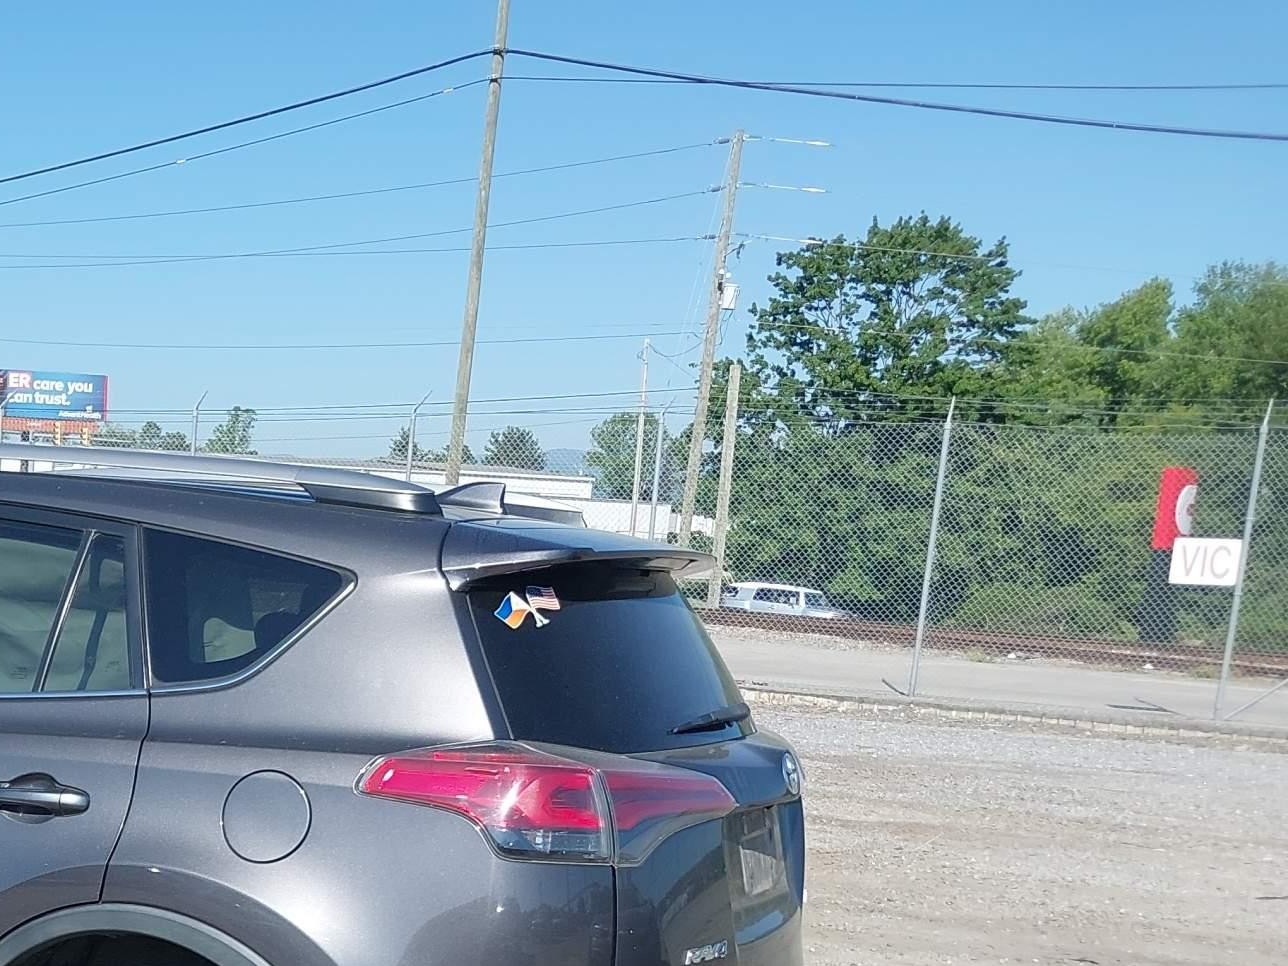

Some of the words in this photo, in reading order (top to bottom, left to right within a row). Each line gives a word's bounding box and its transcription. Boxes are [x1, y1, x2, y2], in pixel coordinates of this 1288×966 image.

[7, 373, 31, 388] ER
[33, 380, 64, 391] care
[67, 382, 94, 395] you
[7, 392, 32, 404] can
[34, 391, 71, 405] trust.
[1182, 545, 1232, 580] VIC
